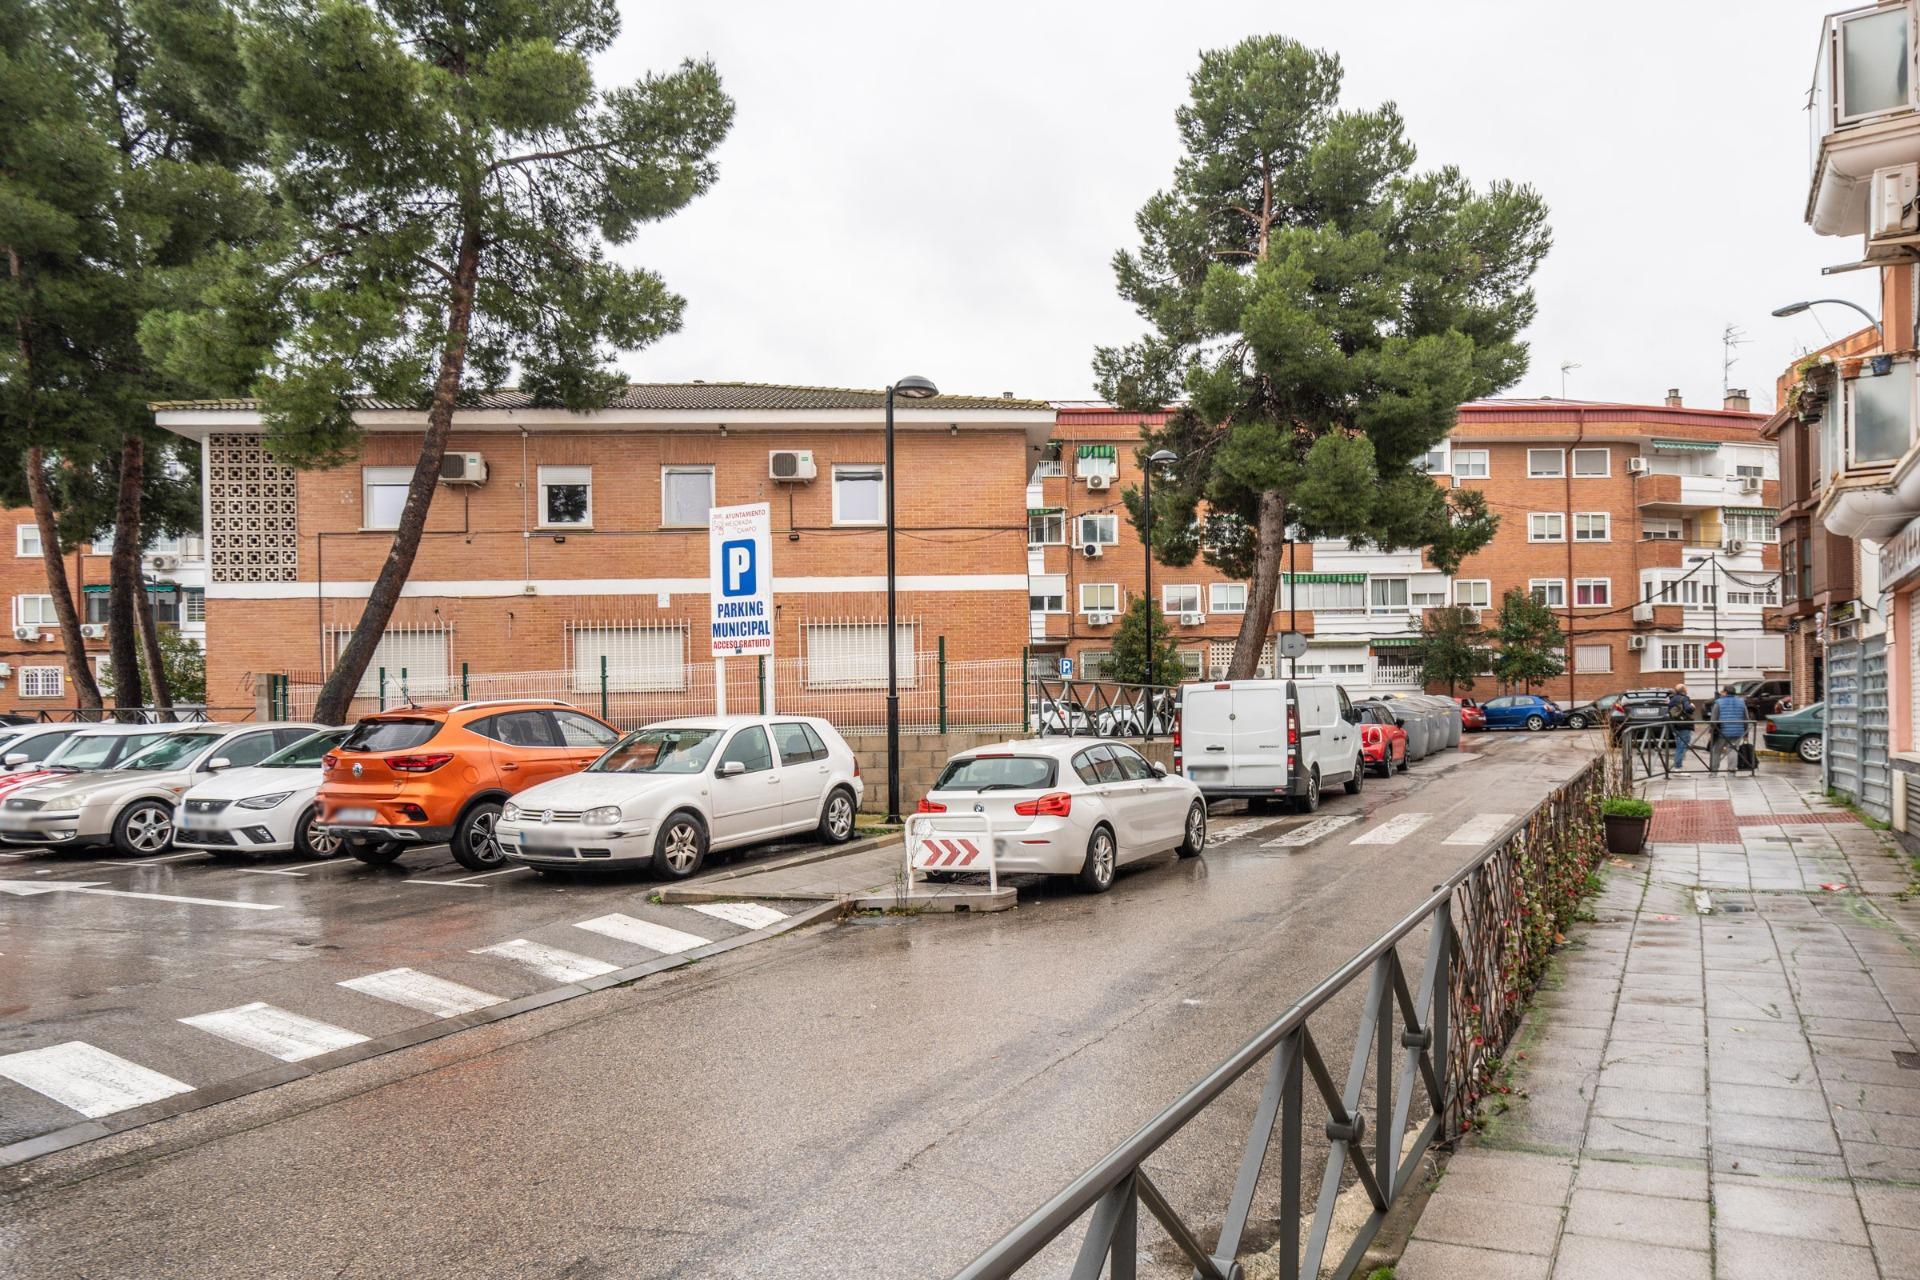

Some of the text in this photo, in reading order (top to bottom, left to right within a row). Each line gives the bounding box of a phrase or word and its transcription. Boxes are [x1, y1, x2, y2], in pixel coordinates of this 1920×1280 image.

[725, 509, 766, 520] AYUNTAMIENTO
[729, 547, 750, 591] P
[717, 600, 764, 618] PARKING
[712, 620, 771, 638] MUNICIPAL
[713, 638, 771, 650] ACCESO GRATUITO
[1062, 660, 1071, 673] P
